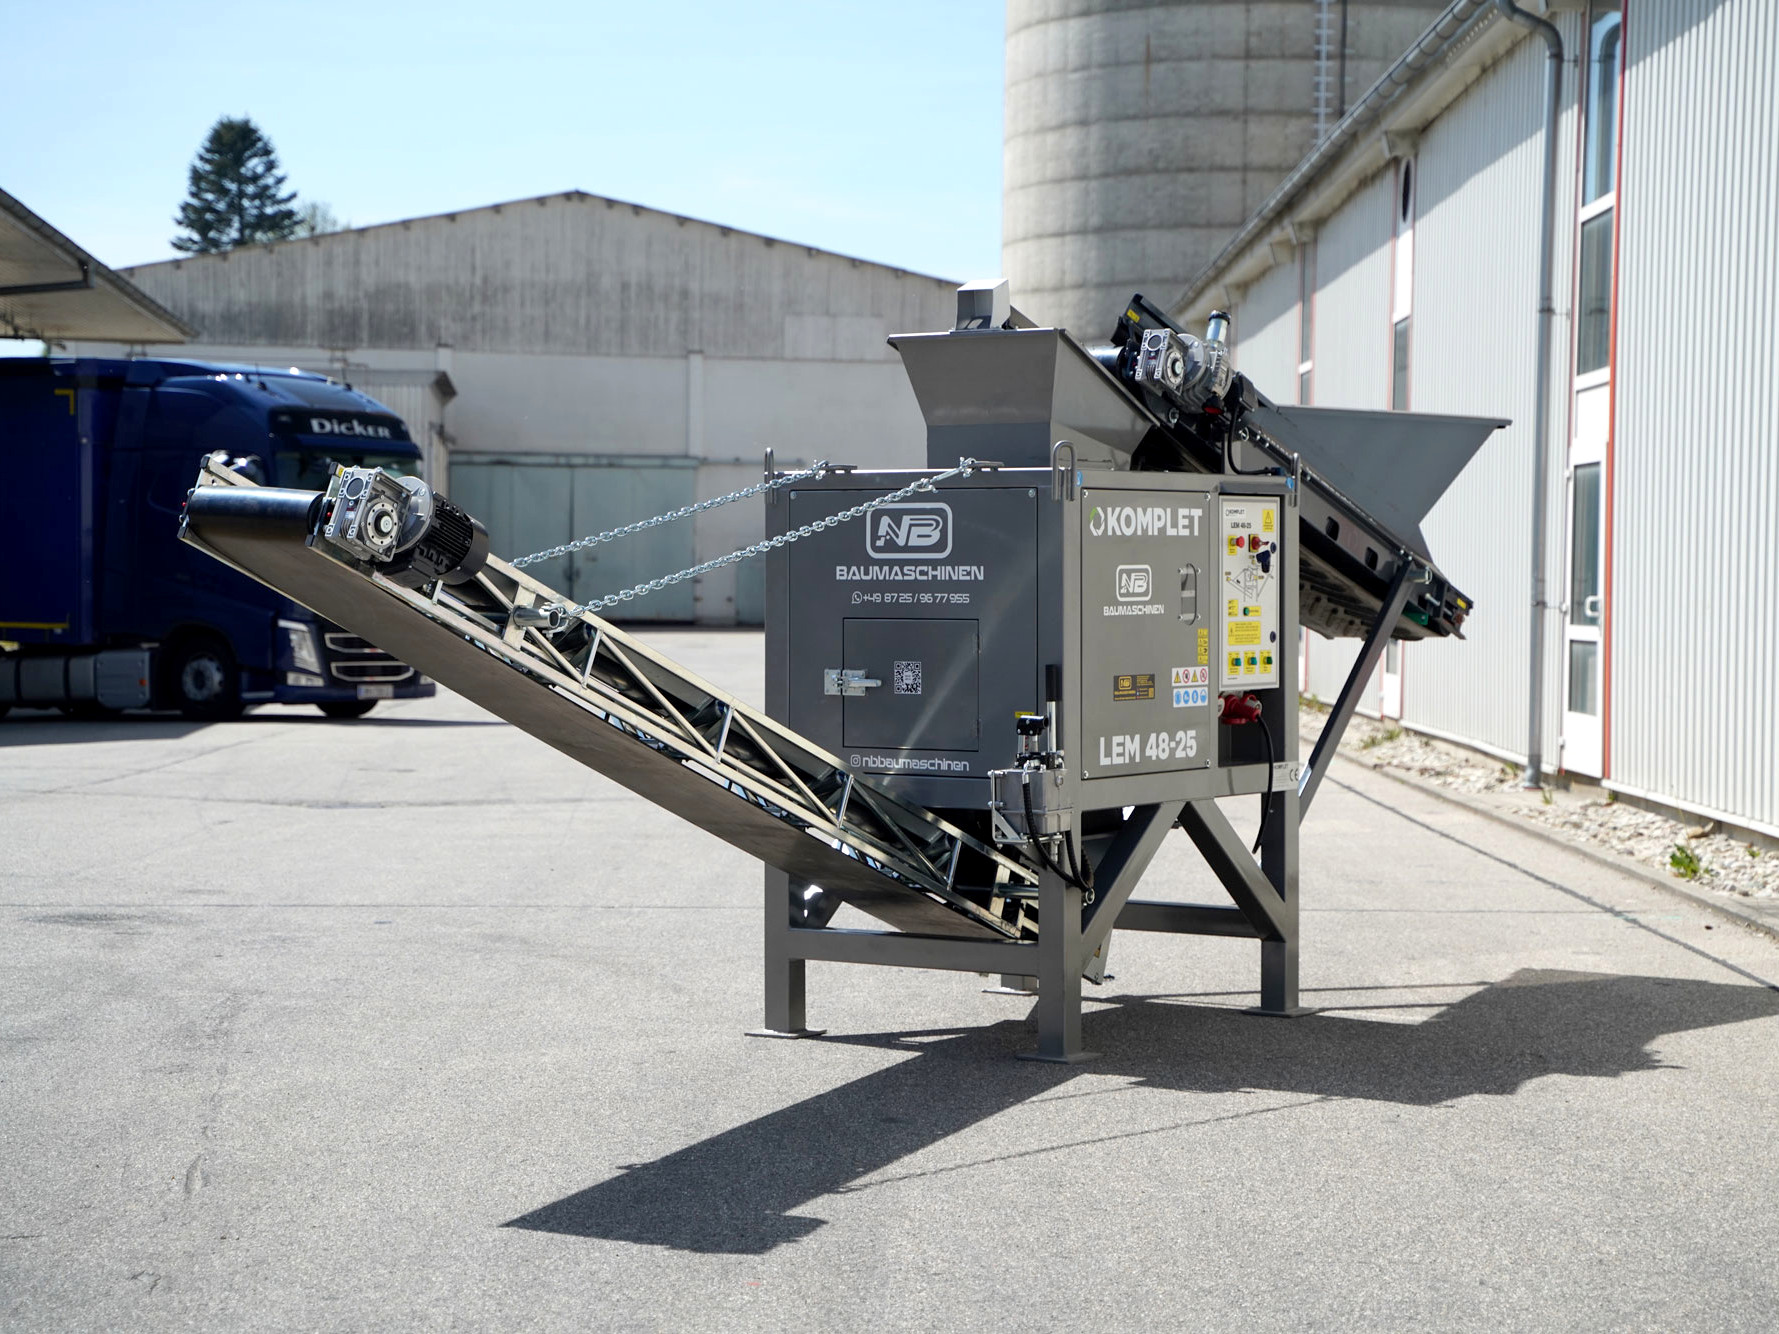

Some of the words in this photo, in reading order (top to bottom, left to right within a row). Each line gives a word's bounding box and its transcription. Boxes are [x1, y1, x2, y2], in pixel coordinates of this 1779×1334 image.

[875, 515, 943, 547] NB
[1107, 507, 1203, 537] KOMPLET
[835, 565, 985, 581] BAUMASCHINEN
[1120, 573, 1149, 594] NB
[1103, 604, 1165, 616] BAUMASCHINEN
[1099, 734, 1140, 766] LEM
[1145, 730, 1198, 760] 48-25
[862, 755, 970, 772] nbbaumaschinen
